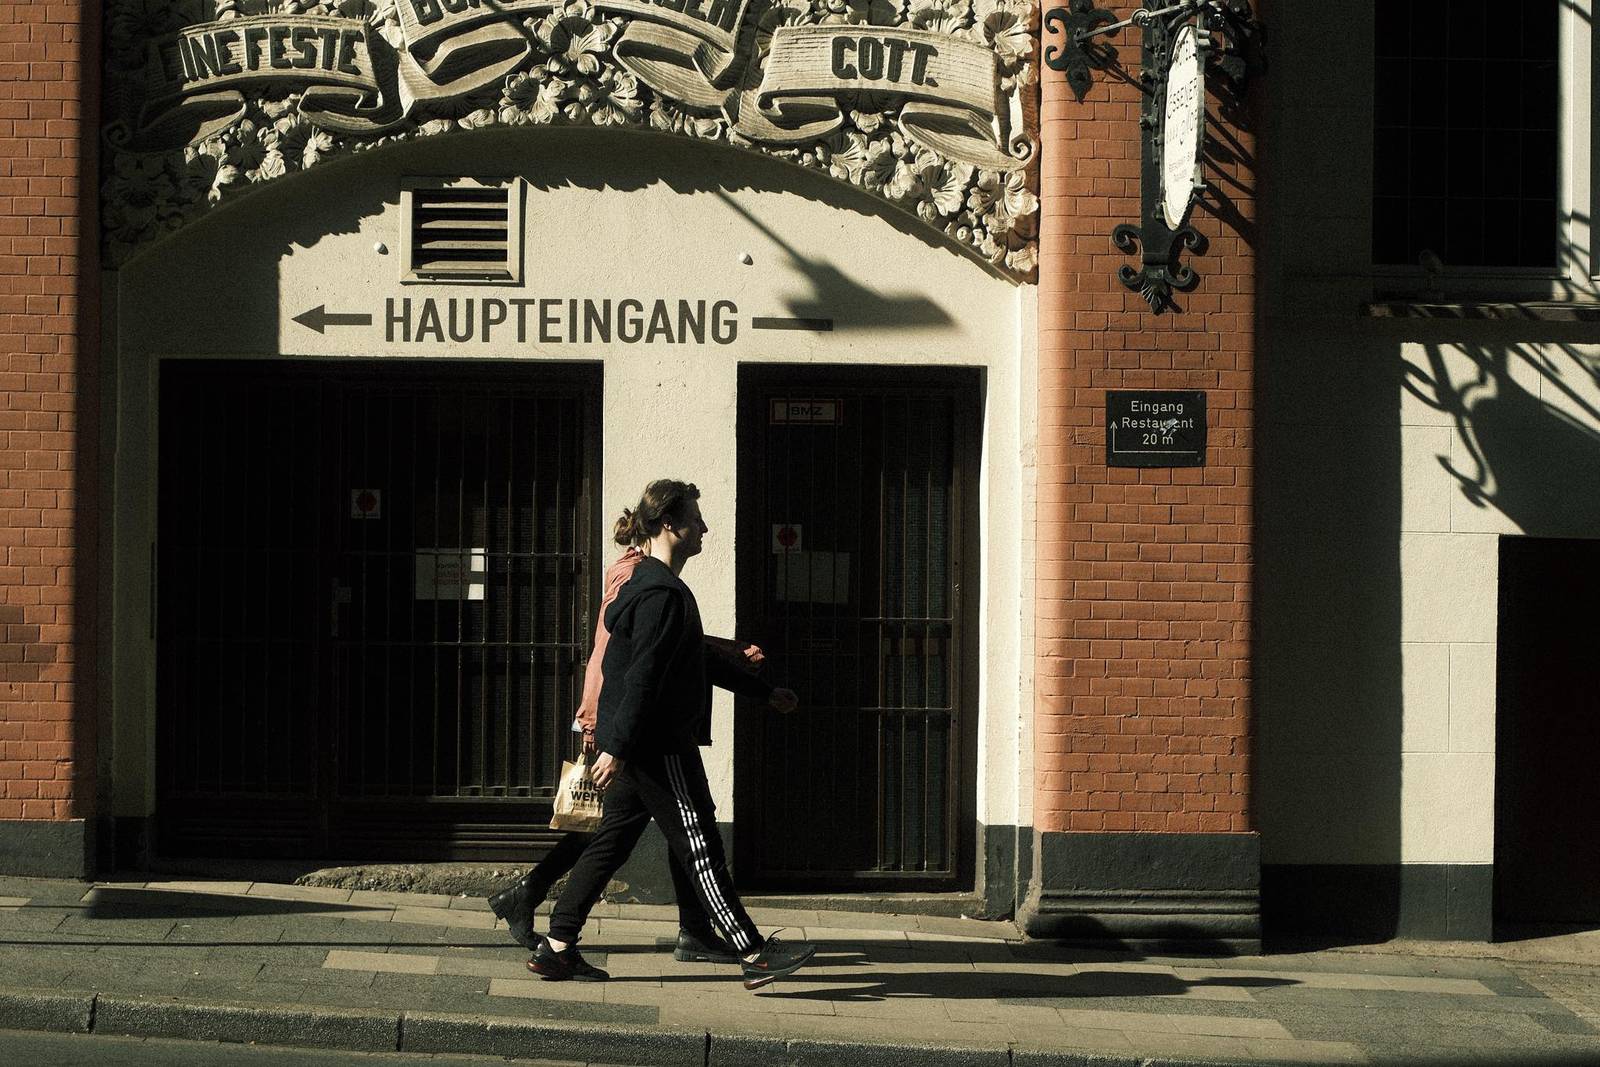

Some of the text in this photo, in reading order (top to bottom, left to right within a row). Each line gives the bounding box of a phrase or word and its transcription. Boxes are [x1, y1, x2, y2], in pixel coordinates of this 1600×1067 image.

[244, 26, 363, 75] FESTE
[385, 297, 738, 345] HAUPTEINGANG
[790, 406, 823, 416] BMZ
[1131, 400, 1184, 415] Eingang
[1142, 433, 1174, 445] 20 m
